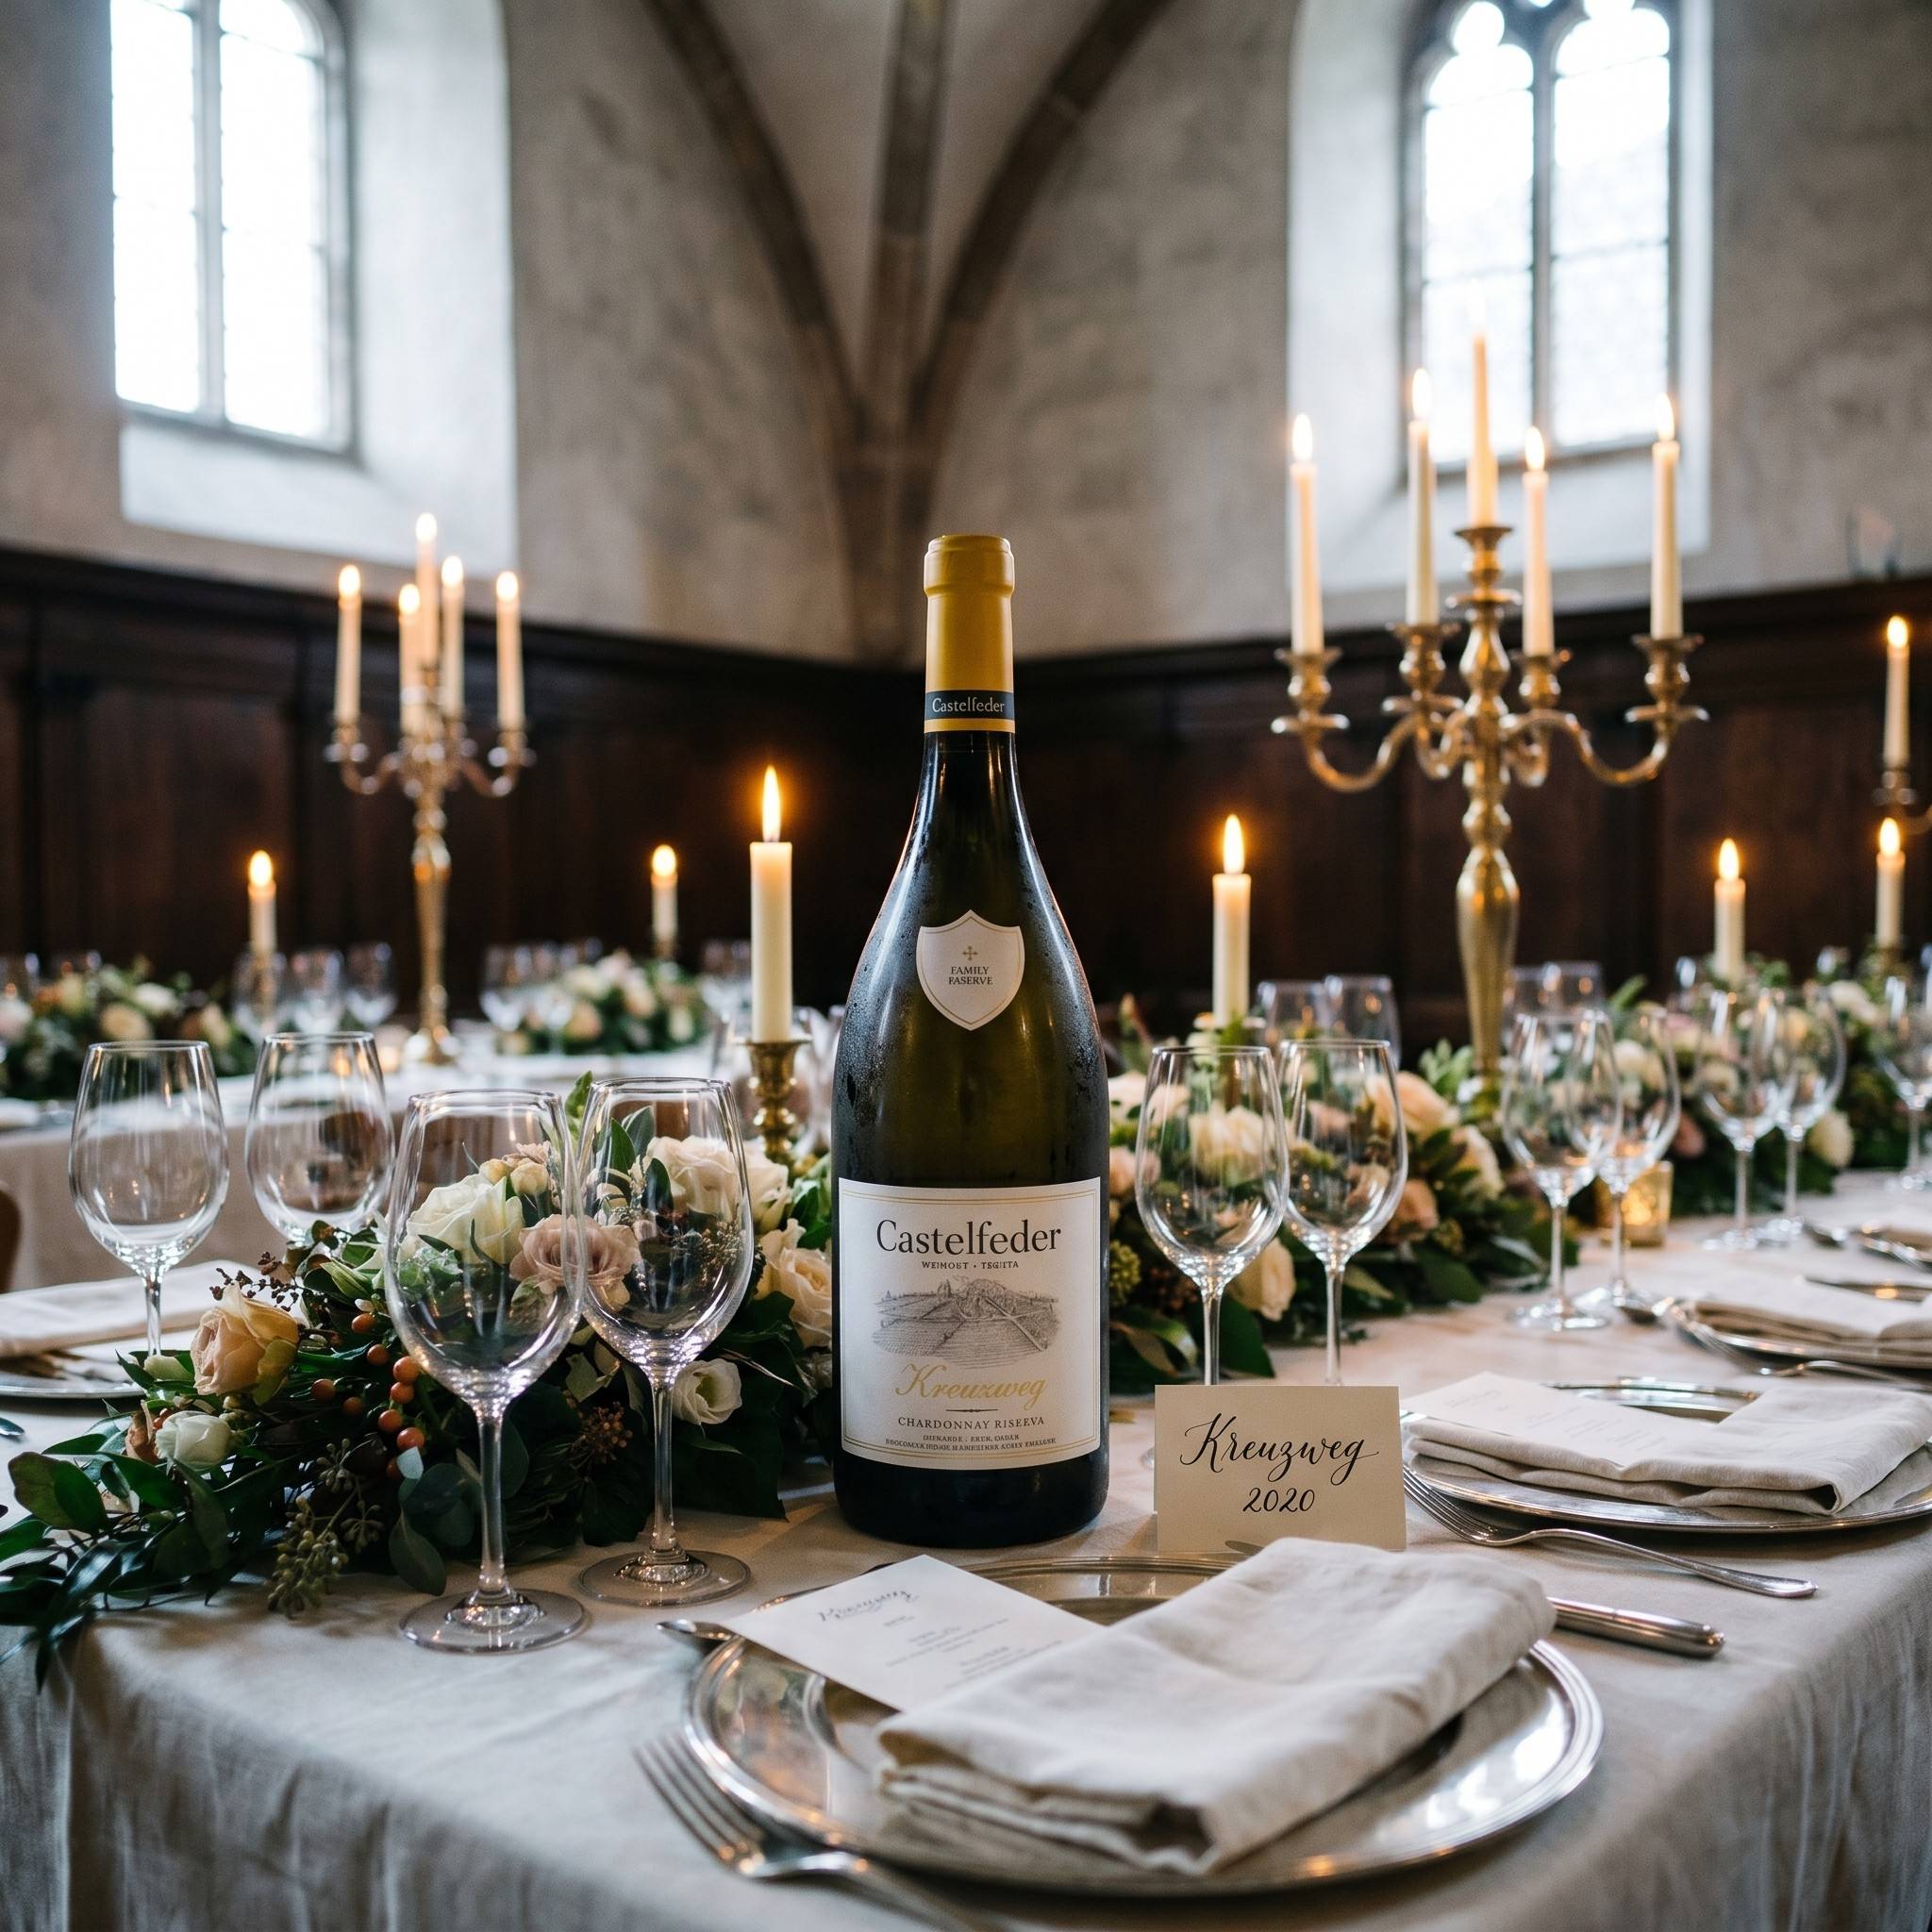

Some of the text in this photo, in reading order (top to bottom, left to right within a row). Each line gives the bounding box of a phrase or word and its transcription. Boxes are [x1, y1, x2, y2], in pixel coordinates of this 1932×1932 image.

[932, 696, 1006, 713] Castelfeder
[951, 966, 990, 975] FAMILY
[876, 1219, 1061, 1256] Castelfeder
[898, 1416, 990, 1430] CHARDONNAY
[1179, 1413, 1379, 1486] Kreuzweg
[1242, 1488, 1315, 1513] 2020
